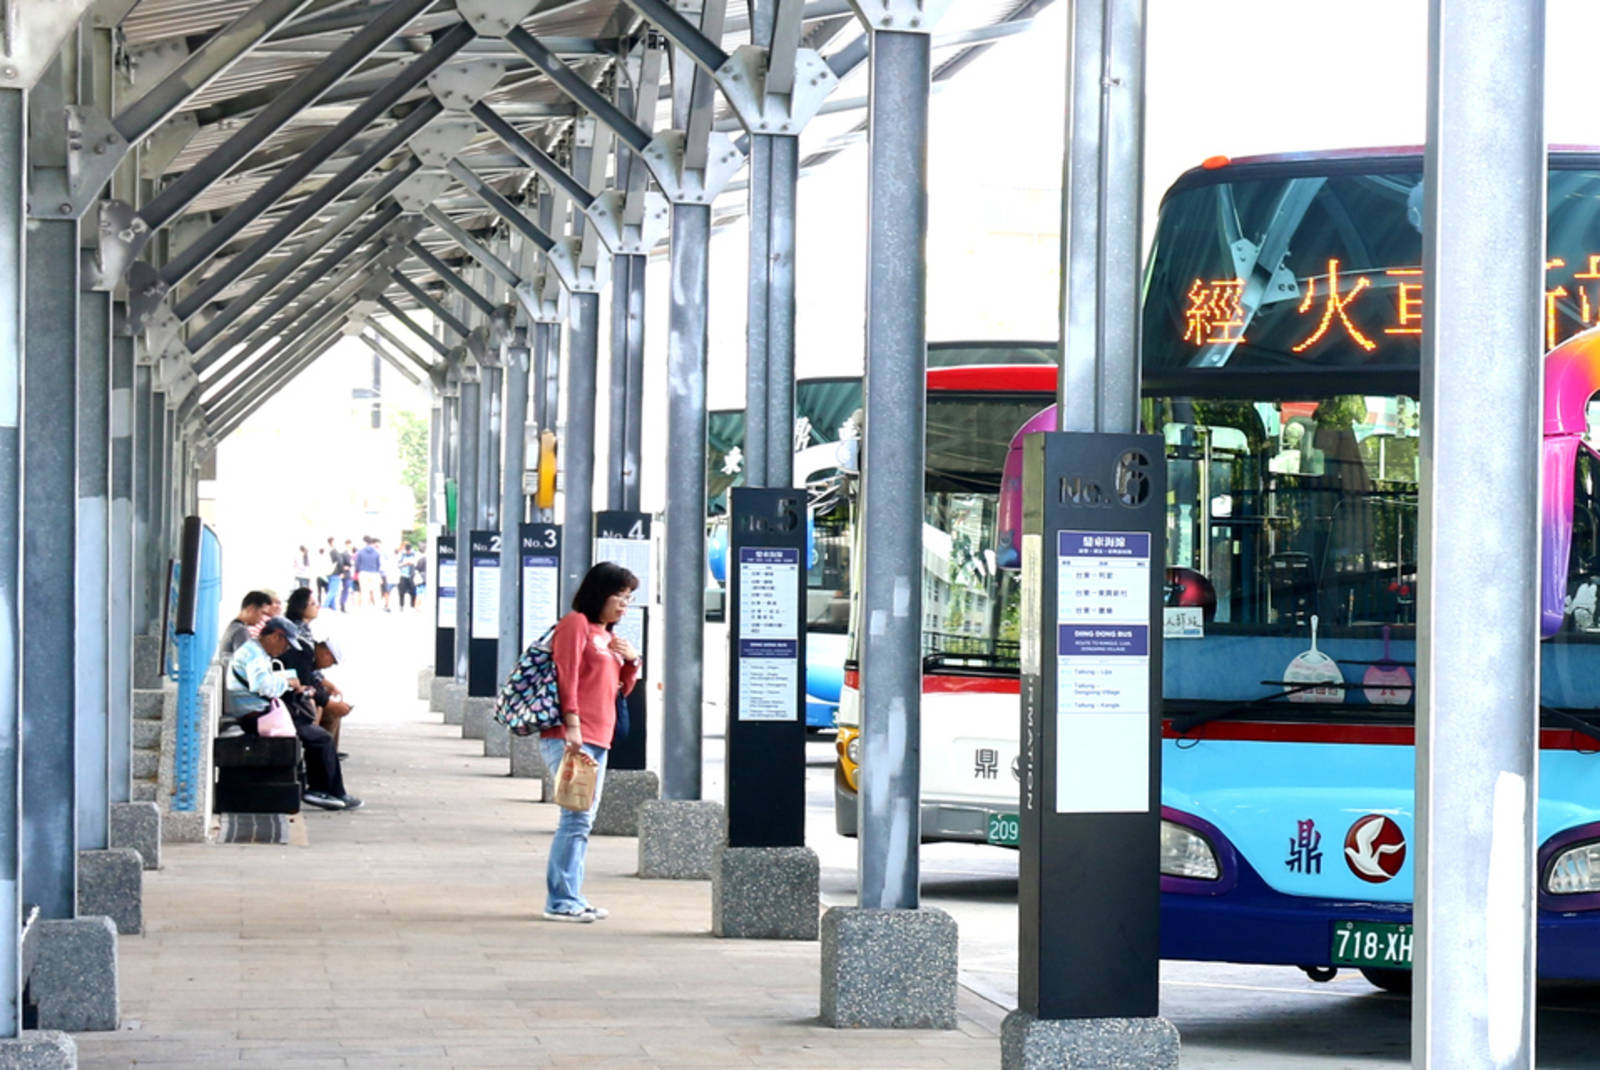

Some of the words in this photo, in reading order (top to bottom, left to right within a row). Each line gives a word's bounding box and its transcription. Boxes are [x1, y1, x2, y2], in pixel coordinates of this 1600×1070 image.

[1183, 277, 1246, 346] 經
[523, 529, 557, 548] No.3
[603, 519, 645, 539] No4
[1026, 680, 1034, 811] RMATION
[974, 748, 999, 779] 鼎
[989, 820, 1019, 840] 209
[1284, 819, 1323, 875] 鼎
[1336, 929, 1413, 962] 718-XH
